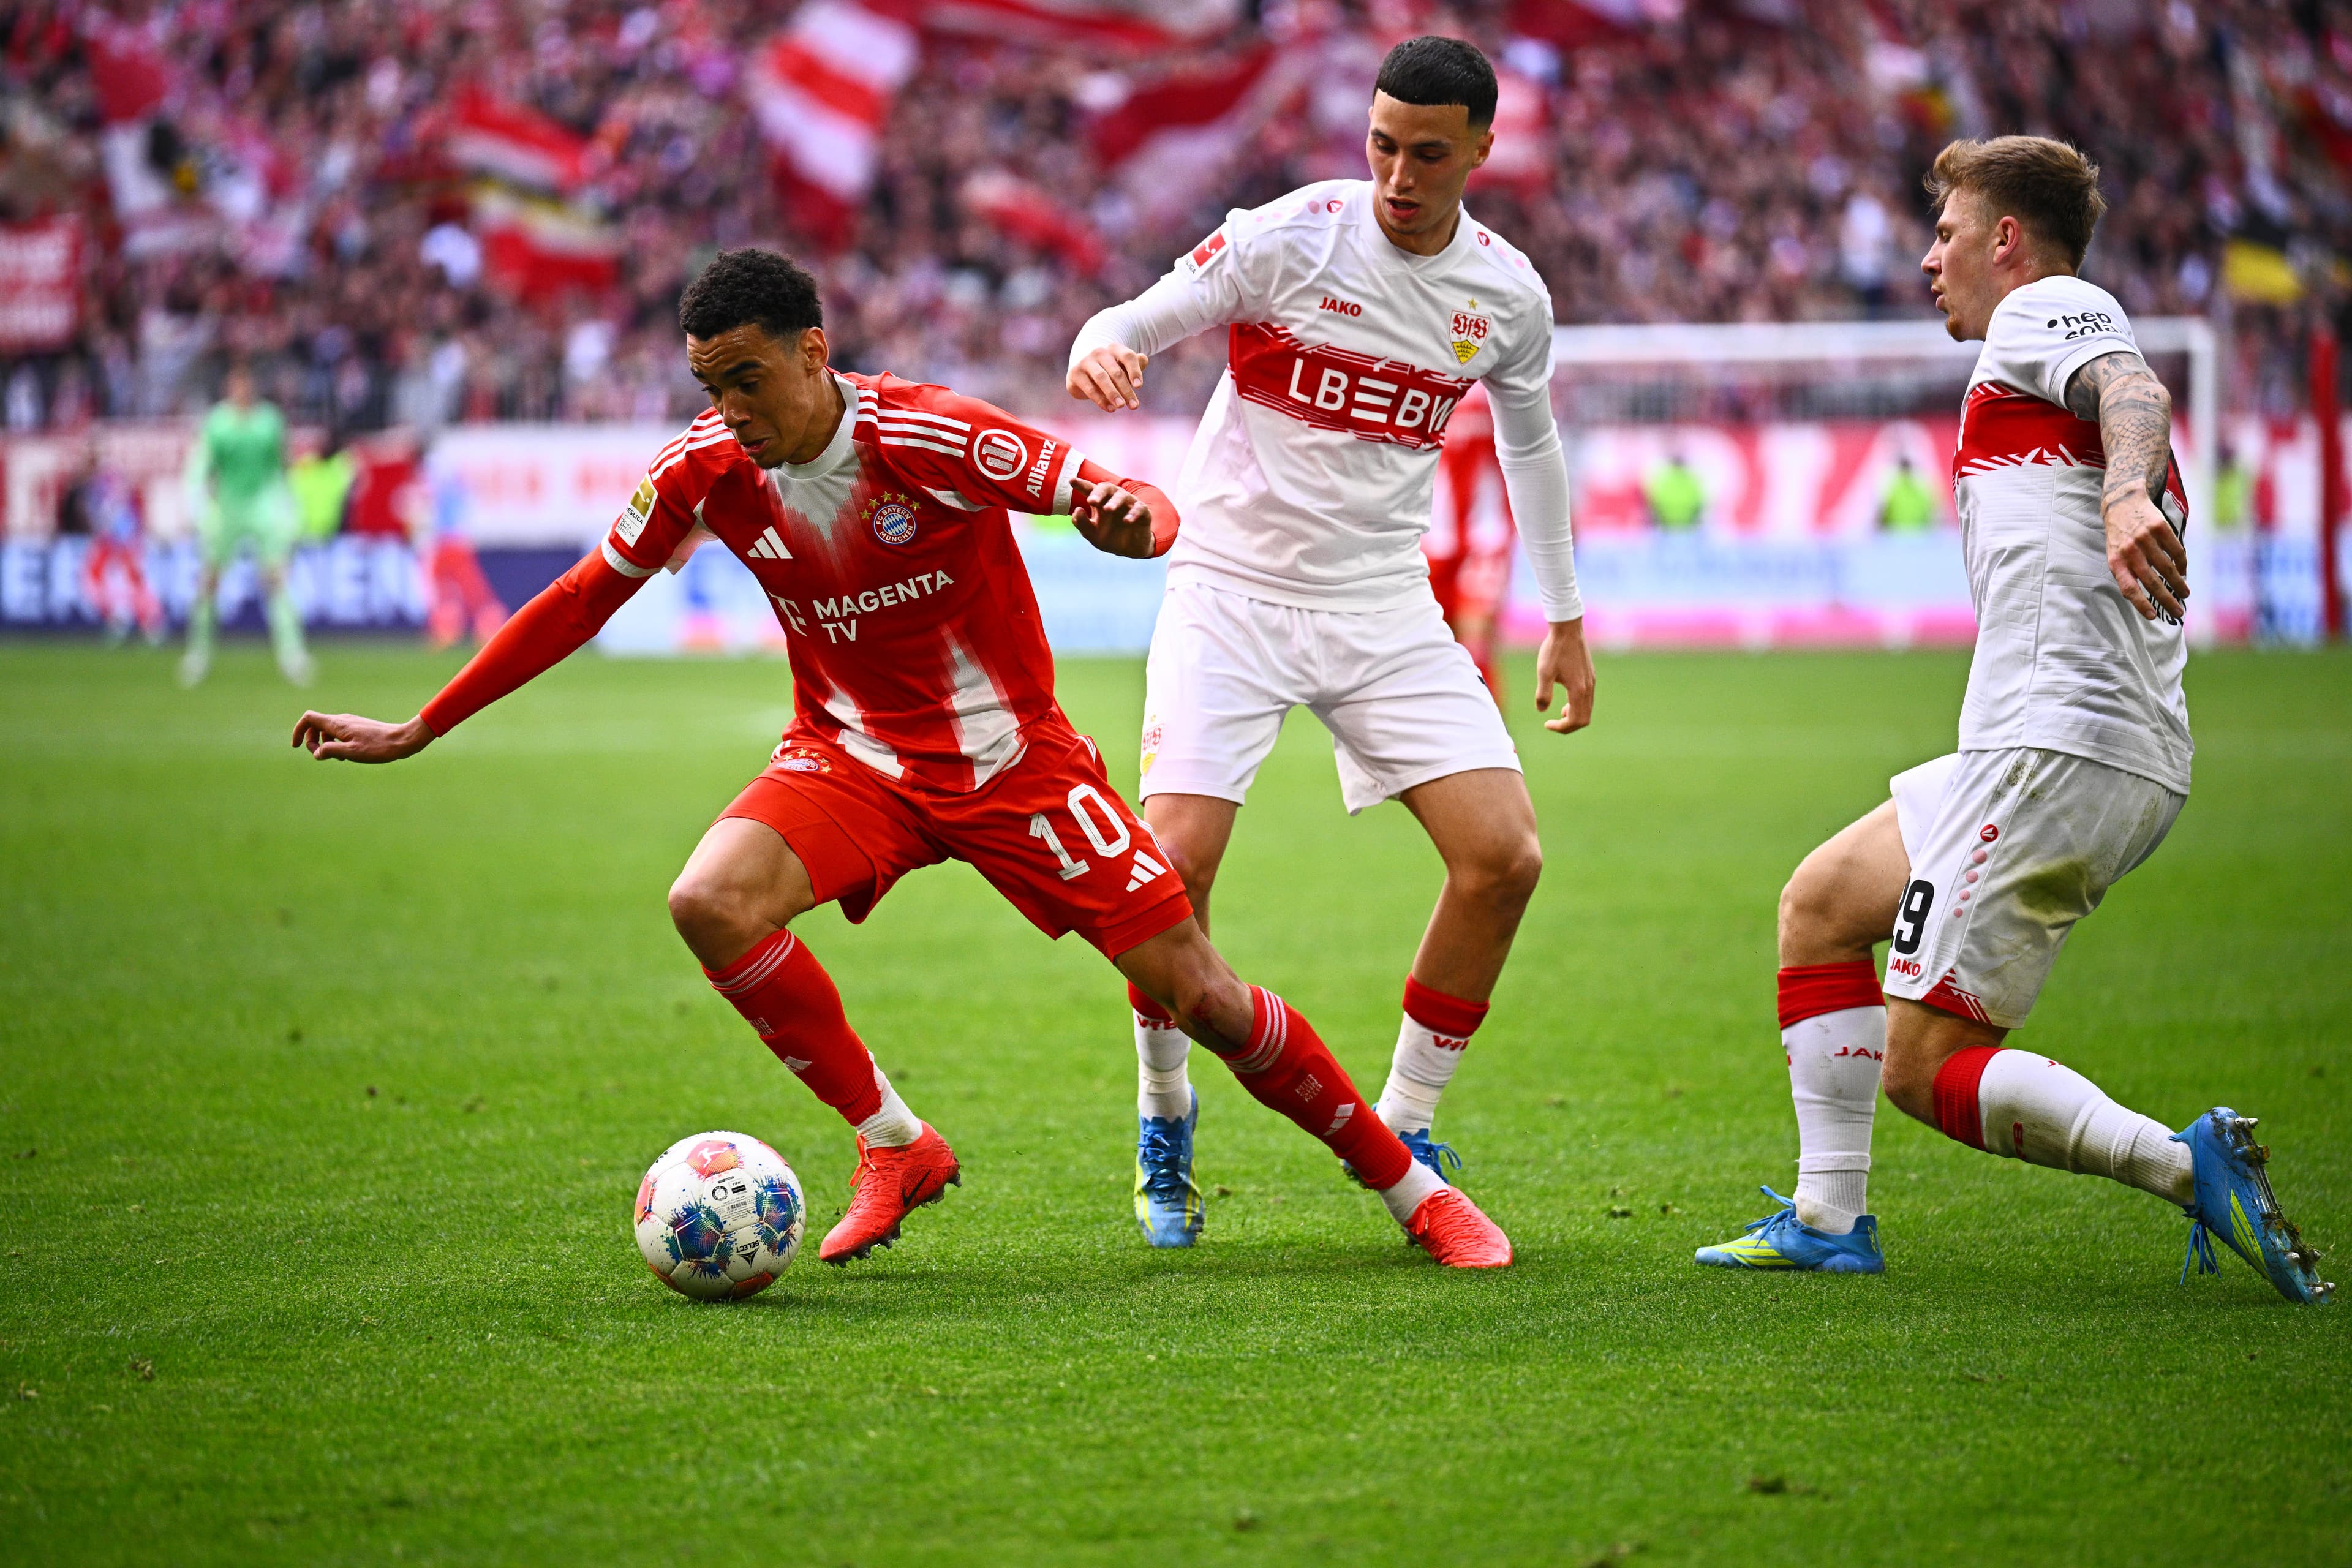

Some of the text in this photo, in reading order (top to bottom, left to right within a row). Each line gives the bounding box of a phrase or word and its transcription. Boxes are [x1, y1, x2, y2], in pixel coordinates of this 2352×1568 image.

[1319, 296, 1362, 317] JAKO
[2061, 312, 2112, 328] hep
[1026, 439, 1057, 499] Allianz
[626, 506, 643, 525] ESLIGA
[876, 507, 911, 525] FC BAYERN
[812, 570, 956, 620] MAGENTA
[821, 619, 857, 644] TV
[1028, 783, 1131, 881] 10
[1890, 875, 1935, 955] 9
[1890, 957, 1921, 977] JAKO
[1834, 1046, 1883, 1062] JAK
[736, 1240, 760, 1253] SELECT
